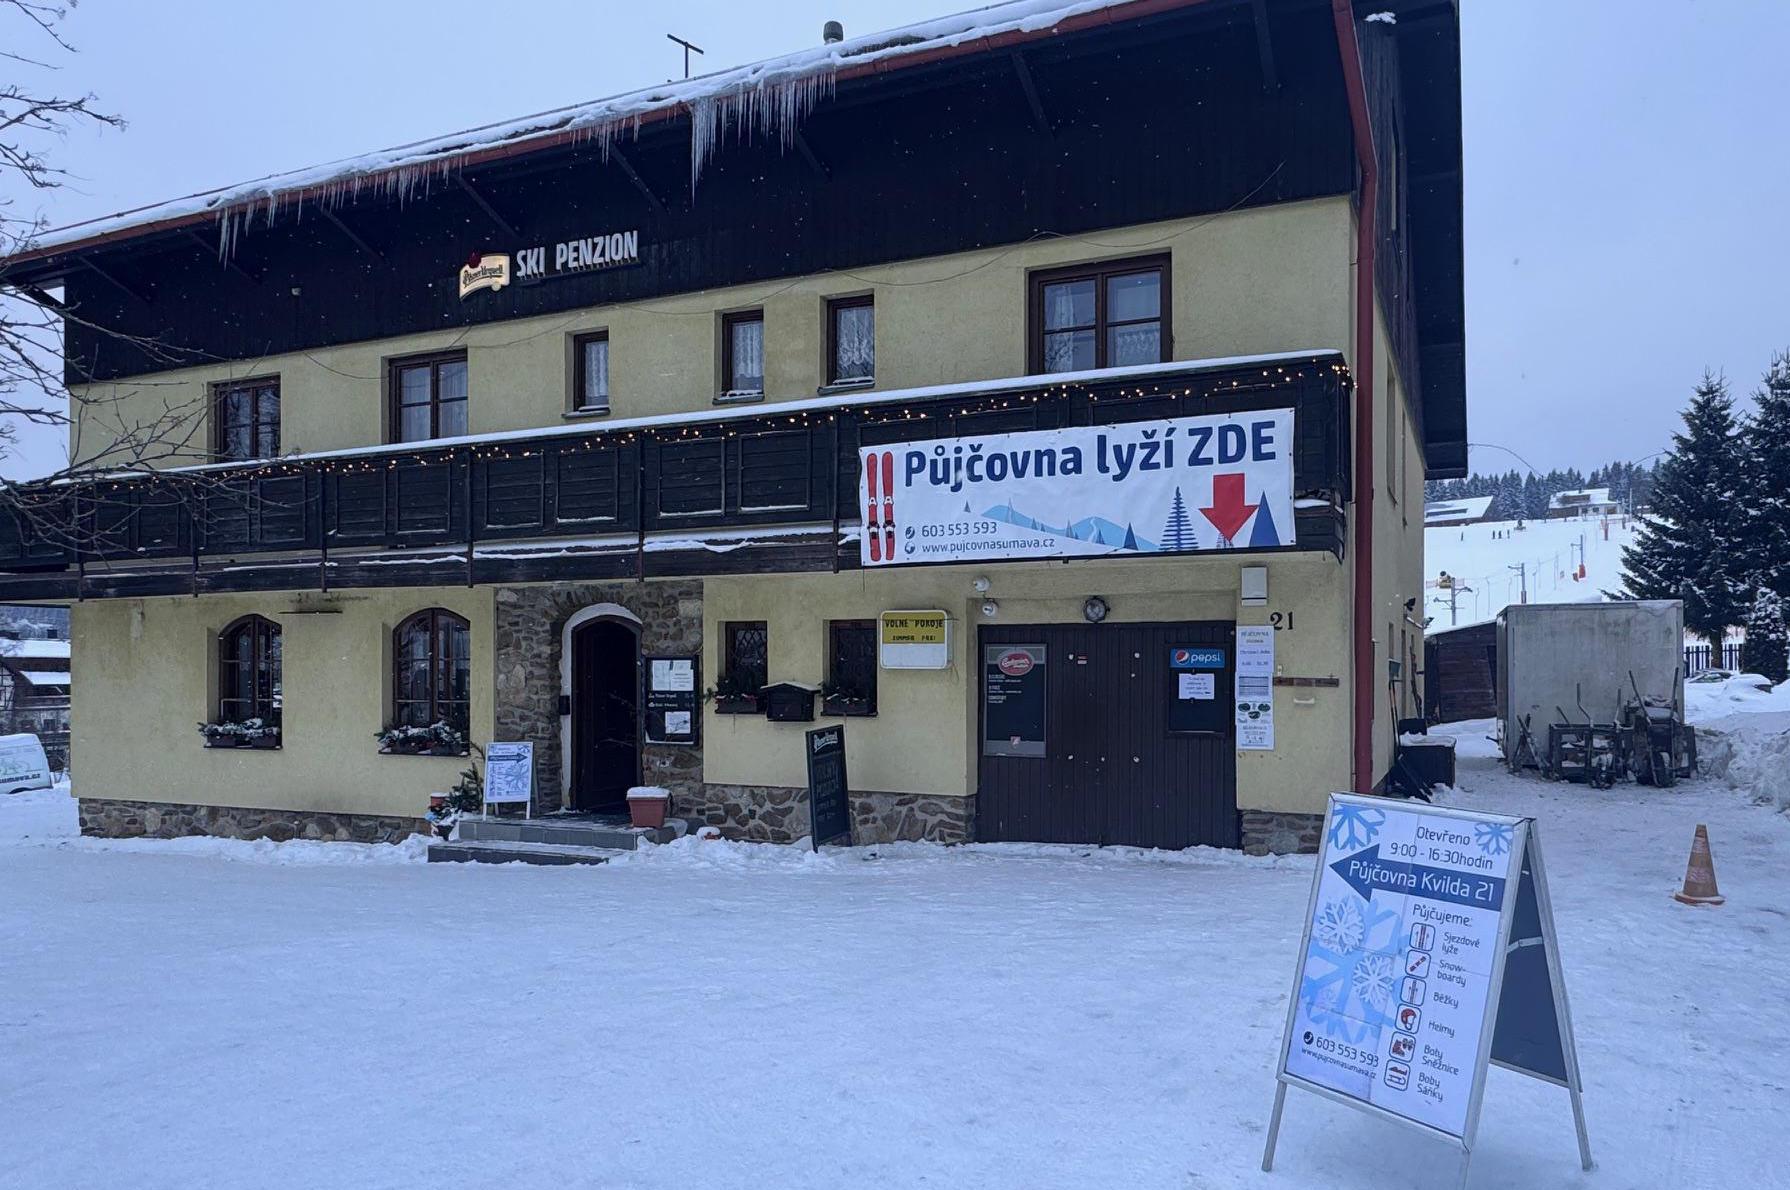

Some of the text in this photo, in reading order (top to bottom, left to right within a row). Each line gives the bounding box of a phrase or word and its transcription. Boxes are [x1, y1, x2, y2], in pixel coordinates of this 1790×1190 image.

[516, 231, 638, 277] SKI PENZION
[905, 420, 1276, 493] Půjčovna lyží ZDE
[922, 521, 997, 538] 603 553 593
[922, 538, 1055, 554] www.pujcovnasumava.cz
[1270, 611, 1294, 631] 21
[1190, 651, 1220, 664] pepsi
[1416, 826, 1471, 846] Otevřeno
[1349, 860, 1494, 902] Půjčovna Kvilda 21
[1412, 903, 1473, 928] Půjčujeme:
[1443, 931, 1480, 948] Sjezdové
[1437, 970, 1467, 988] boardy
[1433, 991, 1459, 1009] Běžky
[1428, 1021, 1455, 1038] Helmy
[1316, 1036, 1379, 1068] 603 553 593
[1421, 1055, 1460, 1076] Sněžnice
[1418, 1072, 1441, 1090] Boby
